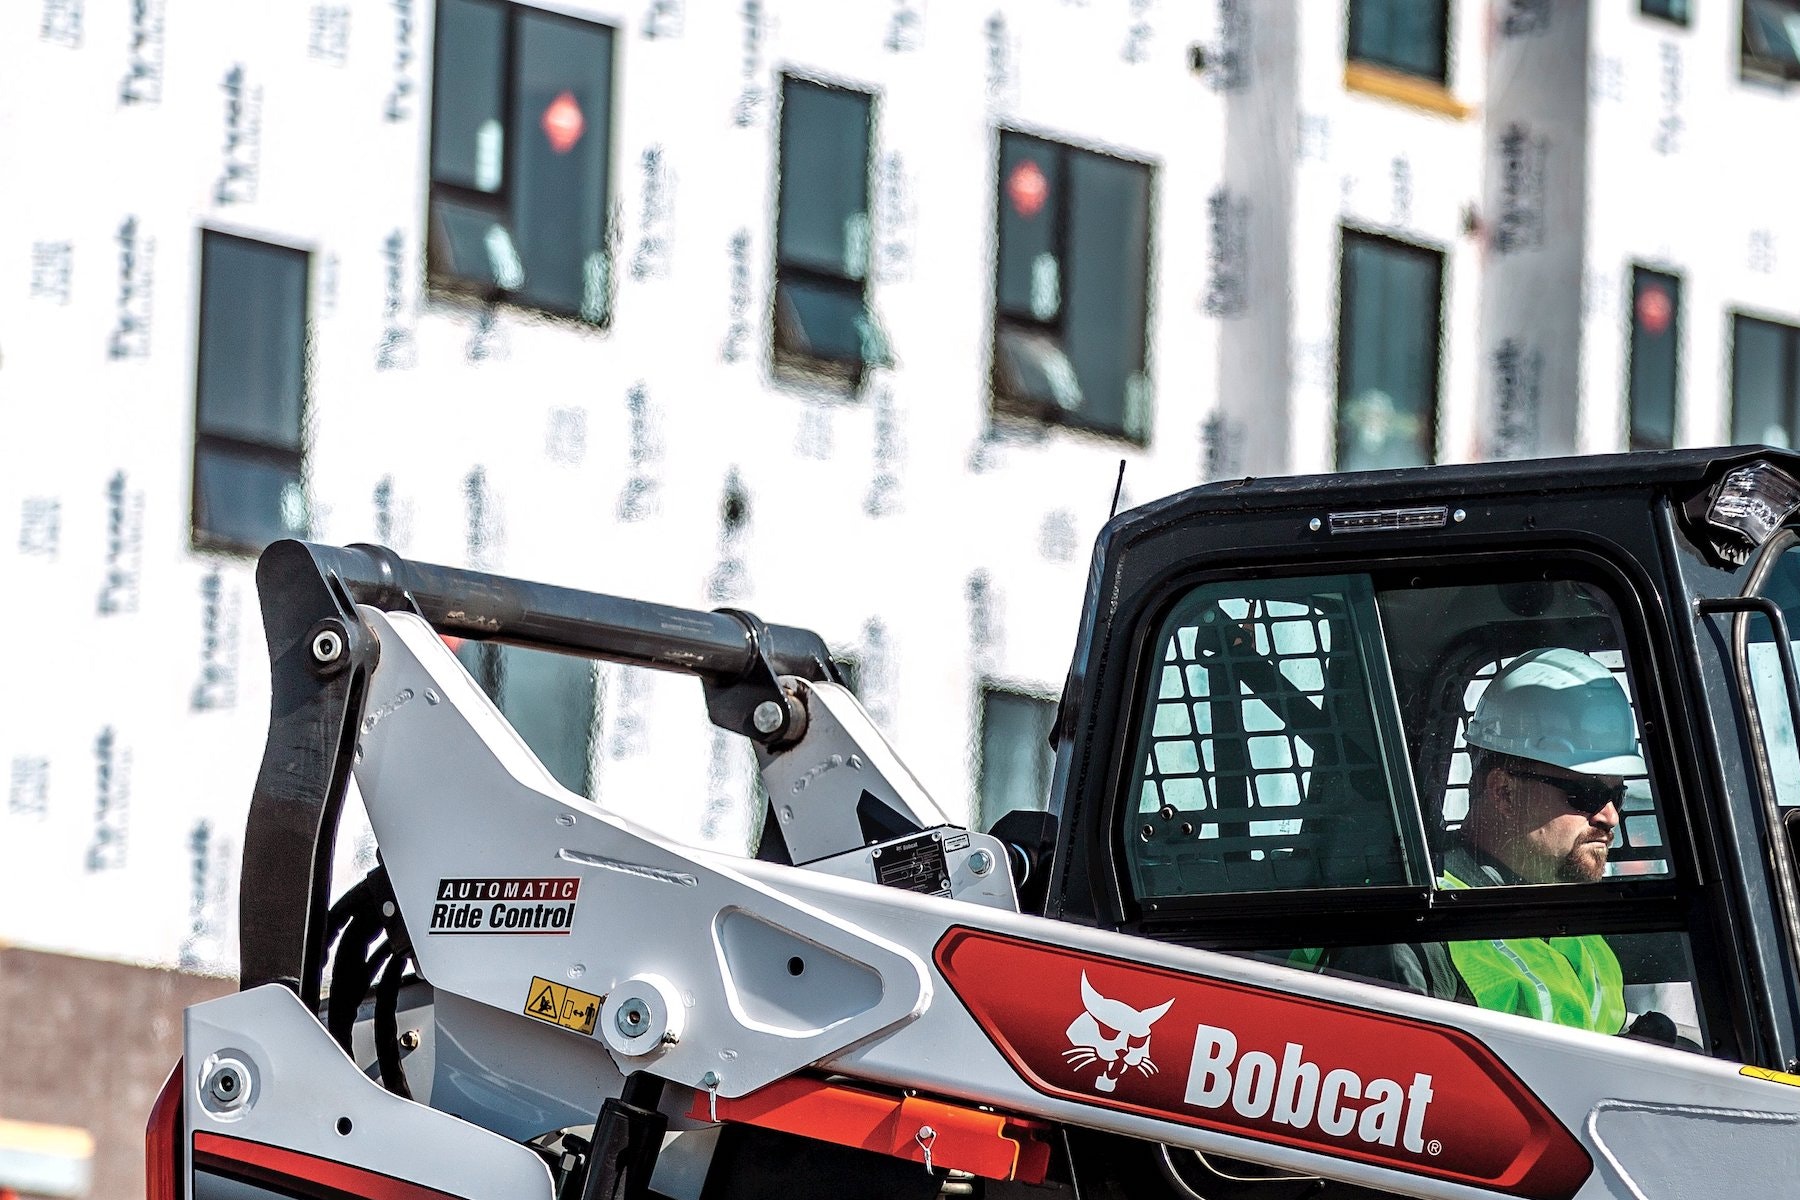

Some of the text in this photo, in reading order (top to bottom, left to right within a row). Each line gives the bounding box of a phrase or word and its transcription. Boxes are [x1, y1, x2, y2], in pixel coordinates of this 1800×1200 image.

[442, 881, 574, 898] AUTOMATIC
[430, 902, 575, 929] Ride Control
